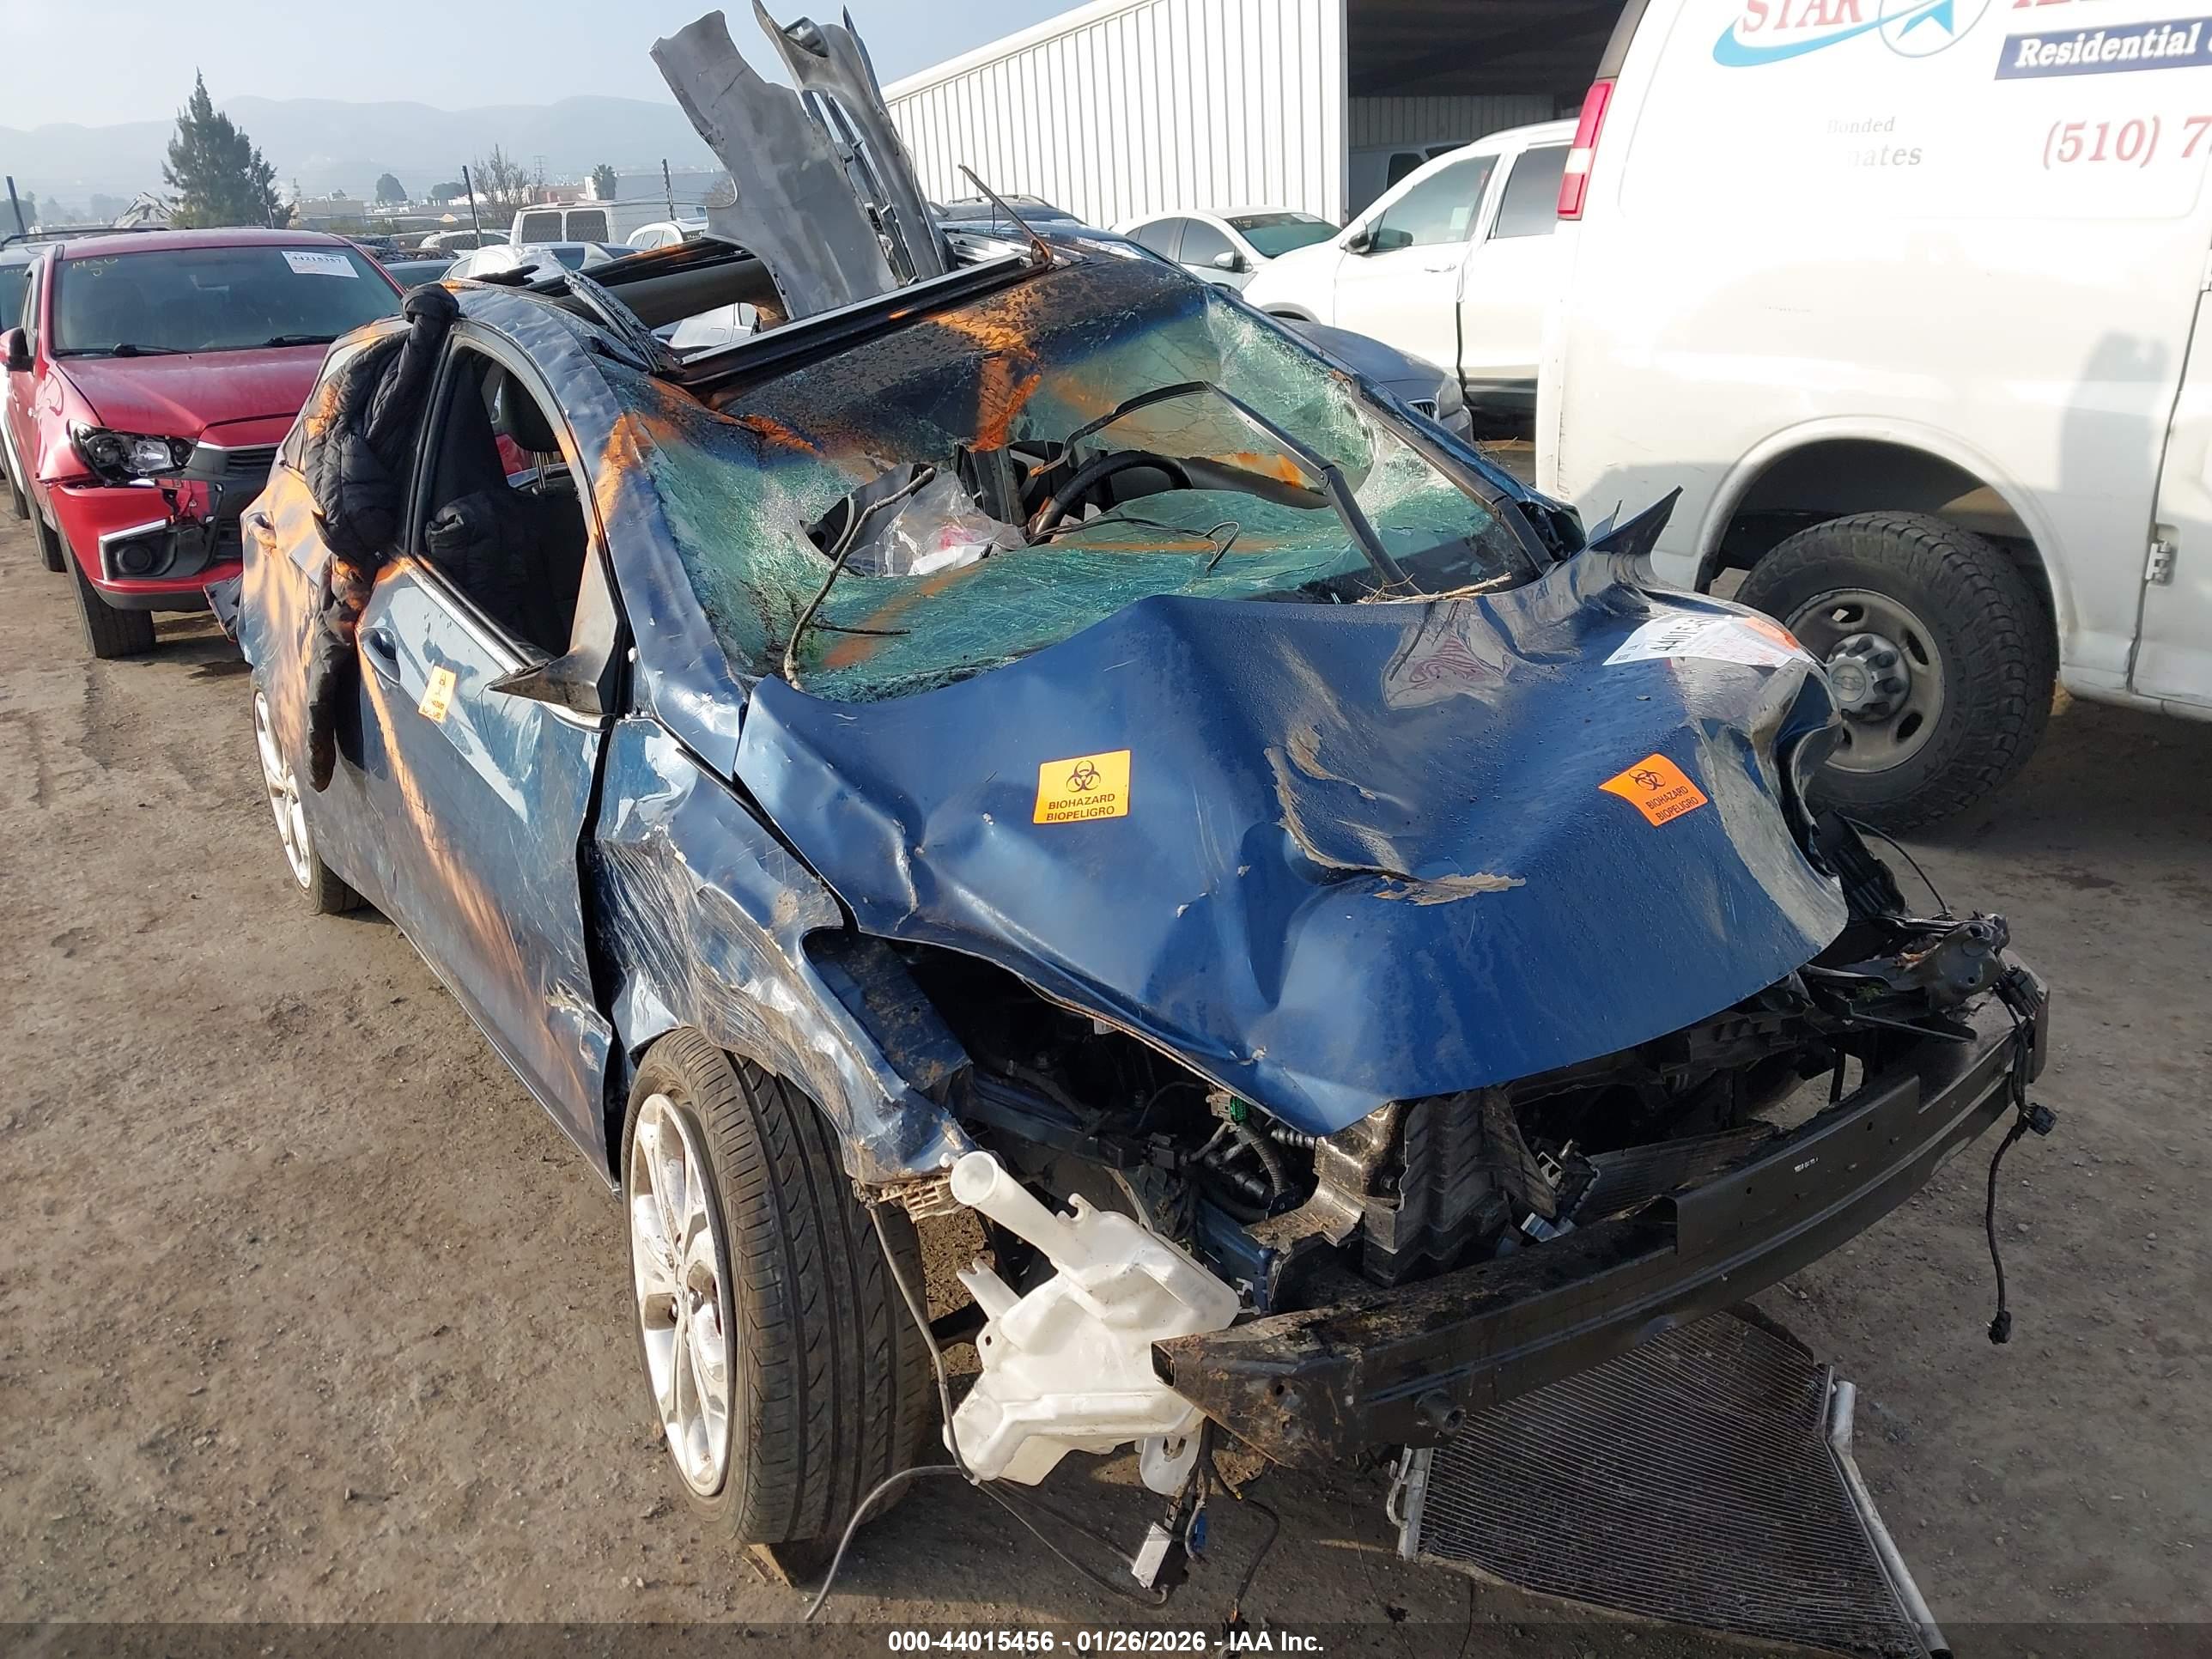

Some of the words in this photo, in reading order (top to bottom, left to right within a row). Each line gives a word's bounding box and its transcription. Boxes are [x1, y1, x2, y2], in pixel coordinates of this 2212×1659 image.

[2014, 22, 2202, 68] Residential
[2043, 115, 2161, 170] (510)
[1048, 793, 1115, 810] BIOHAZARD
[1644, 786, 1689, 810] BIOHAZARD
[1655, 796, 1699, 821] BIOPELIGRO
[1046, 805, 1115, 821] BIOPELIGRO
